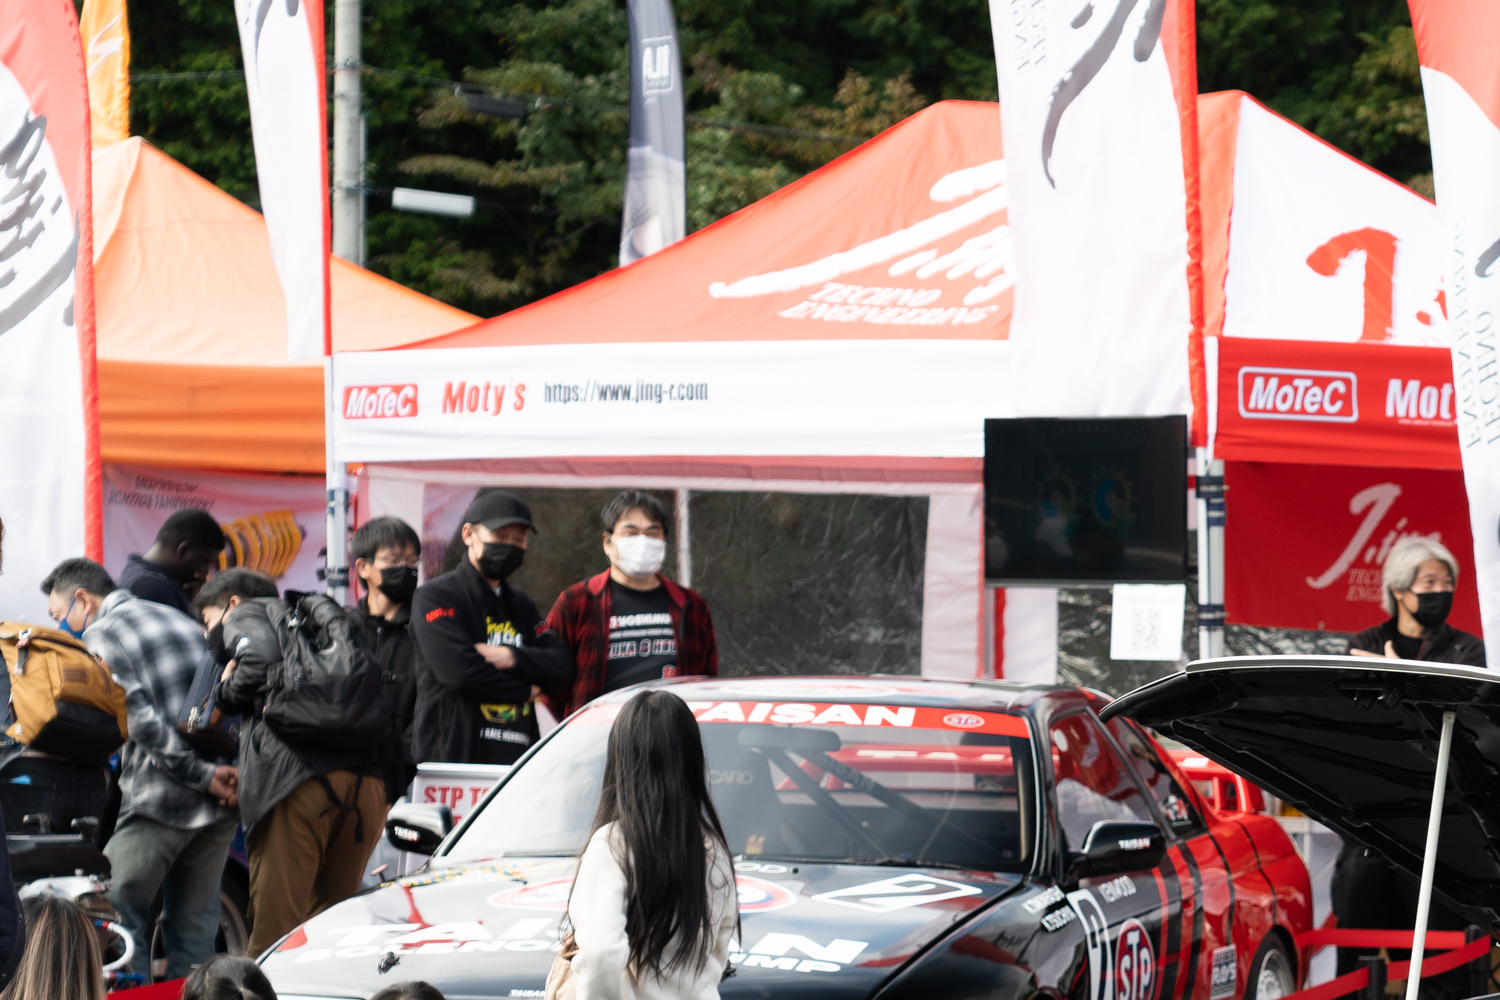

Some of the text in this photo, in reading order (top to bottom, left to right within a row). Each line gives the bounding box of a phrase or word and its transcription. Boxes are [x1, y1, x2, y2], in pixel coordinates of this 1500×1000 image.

[808, 282, 943, 308] TECHNO
[777, 301, 1000, 326] ENGINEERING
[346, 385, 414, 418] MoTeC
[441, 379, 527, 417] Moty's
[1248, 375, 1346, 414] MoTeC
[686, 700, 917, 727] TAISAN
[710, 770, 754, 786] CARO
[424, 784, 464, 809] STP
[1118, 837, 1150, 850] TAISAN
